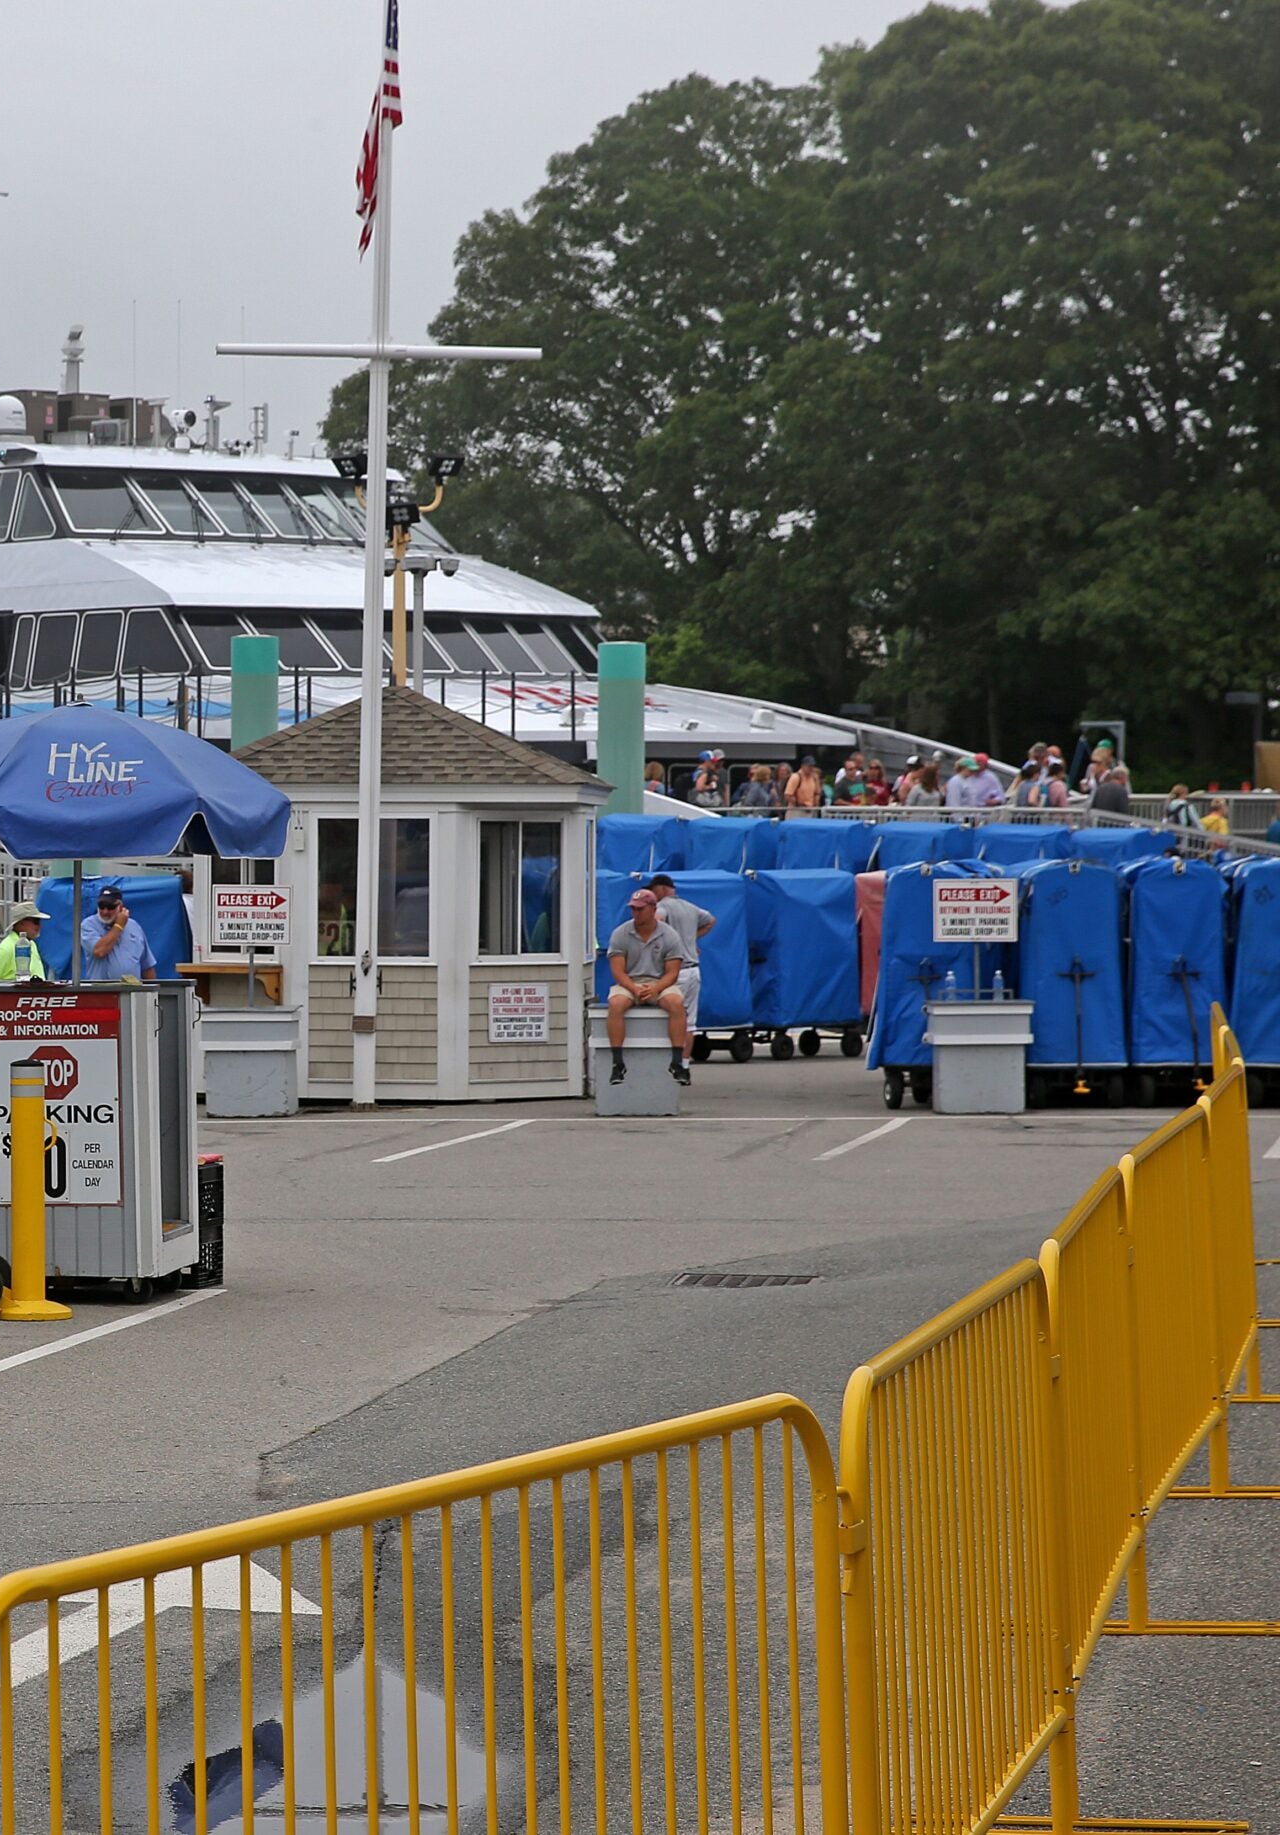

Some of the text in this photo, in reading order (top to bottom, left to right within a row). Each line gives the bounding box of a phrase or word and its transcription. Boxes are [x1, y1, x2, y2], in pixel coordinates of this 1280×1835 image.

[67, 760, 144, 783] LINE
[45, 780, 151, 803] Cruises
[941, 889, 1000, 900] PLEASE EXIT
[220, 895, 277, 906] PLEASE EXIT
[939, 906, 1011, 914] BETWEEN BUILDINGS
[217, 911, 287, 920] BETWEEN BUILDINGS
[220, 922, 285, 931] 5 MINUTE PARKING
[949, 918, 976, 926] MINUTE
[978, 918, 1009, 926] PARKING
[219, 932, 285, 940] LUGGAGE DROP-OFF
[16, 996, 79, 1008] FREE
[13, 1024, 99, 1036] INFORMATION
[42, 1059, 74, 1087] TOP
[84, 1144, 101, 1153] PER
[72, 1160, 114, 1169] CALENDAR
[85, 1177, 101, 1187] DAY
